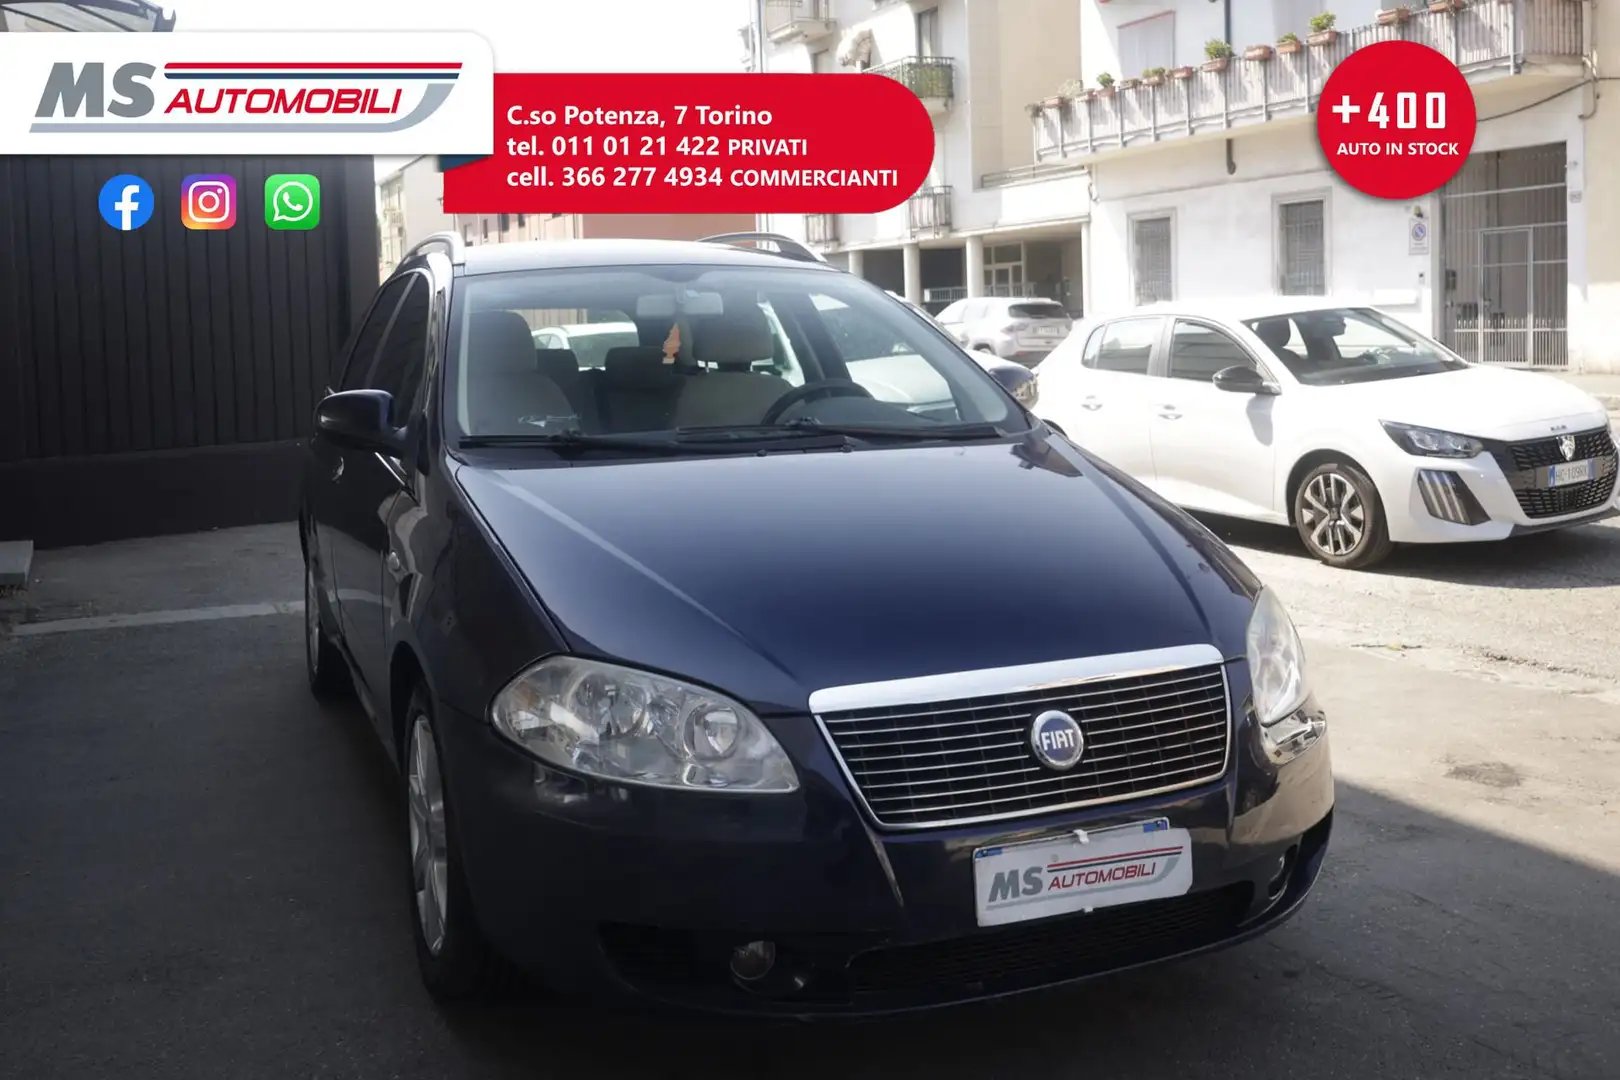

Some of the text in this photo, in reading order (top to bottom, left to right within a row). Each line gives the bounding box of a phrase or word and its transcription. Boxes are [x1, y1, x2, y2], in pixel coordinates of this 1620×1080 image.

[1041, 728, 1074, 751] FIAT
[988, 861, 1157, 903] MS AUTOMOBILI
